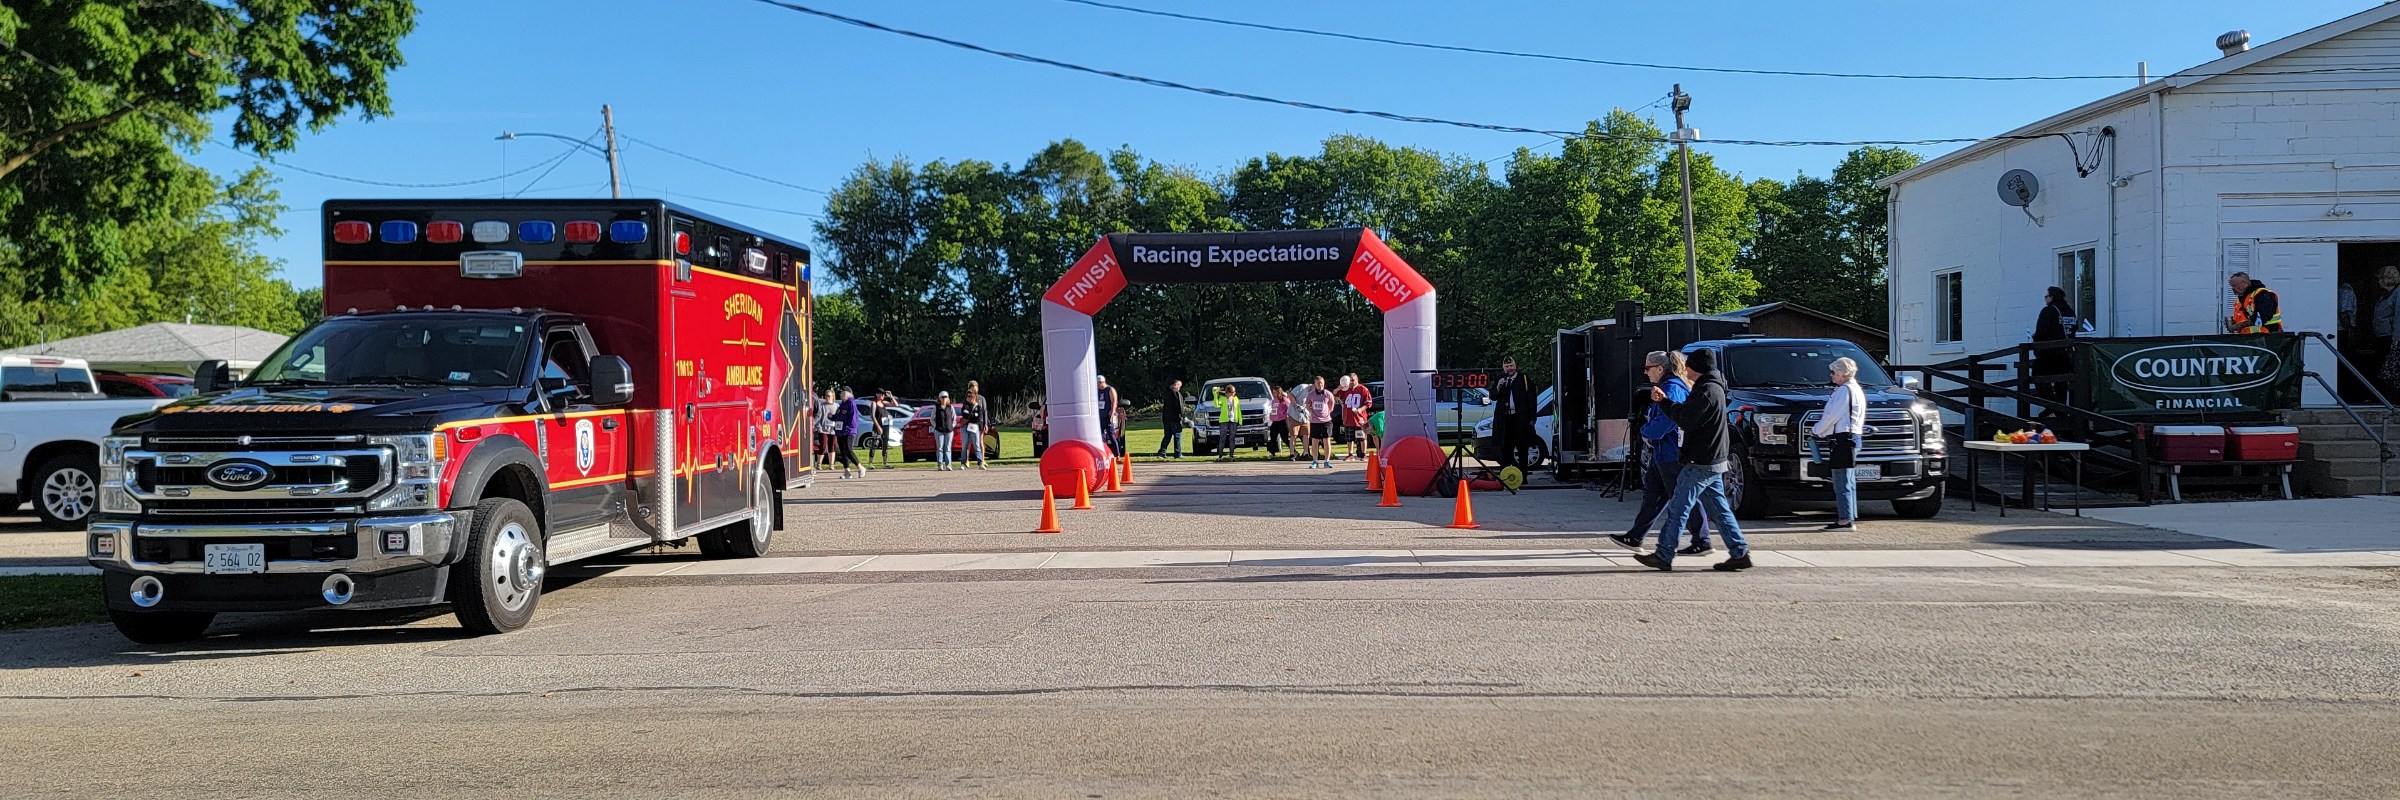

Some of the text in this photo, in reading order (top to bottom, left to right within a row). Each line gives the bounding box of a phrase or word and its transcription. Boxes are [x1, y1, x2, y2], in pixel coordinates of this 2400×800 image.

[1133, 244, 1340, 268] Racing Expectations
[1063, 253, 1116, 306] FINISH
[1356, 250, 1411, 302] FINISH
[724, 293, 763, 326] SHERIDAN
[675, 360, 694, 377] 1M13
[726, 365, 763, 386] AMBULANCE
[1344, 393, 1361, 408] 40
[2156, 397, 2243, 410] FINANCIAL
[220, 467, 253, 481] Ford
[207, 552, 261, 567] 2 564 02
